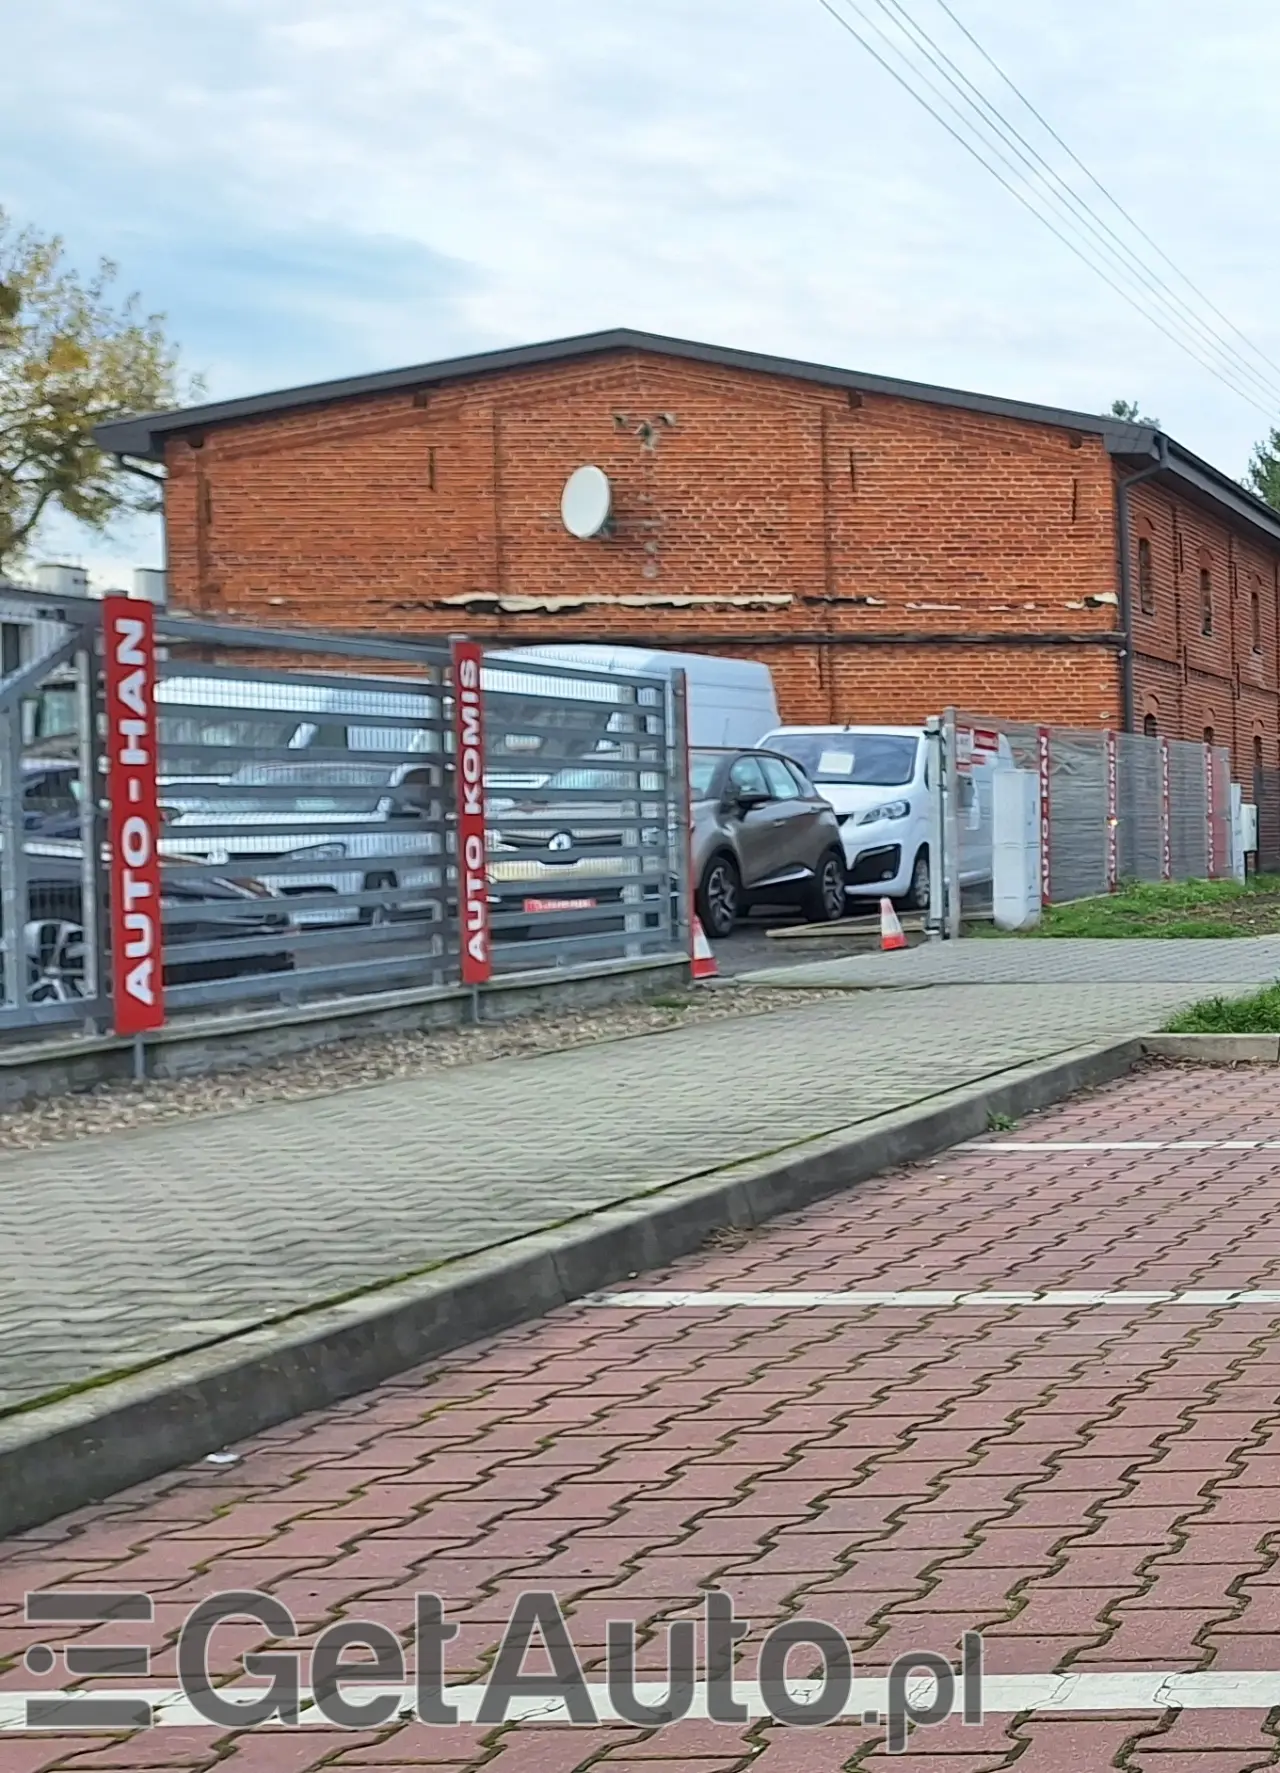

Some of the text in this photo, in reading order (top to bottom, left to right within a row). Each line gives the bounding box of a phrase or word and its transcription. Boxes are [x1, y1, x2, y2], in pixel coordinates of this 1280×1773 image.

[115, 618, 149, 765] HAN
[460, 659, 485, 963] AUTO KOMIS
[1039, 735, 1049, 798] HAN
[122, 815, 154, 1006] AUTO
[1040, 817, 1049, 897] AUTO
